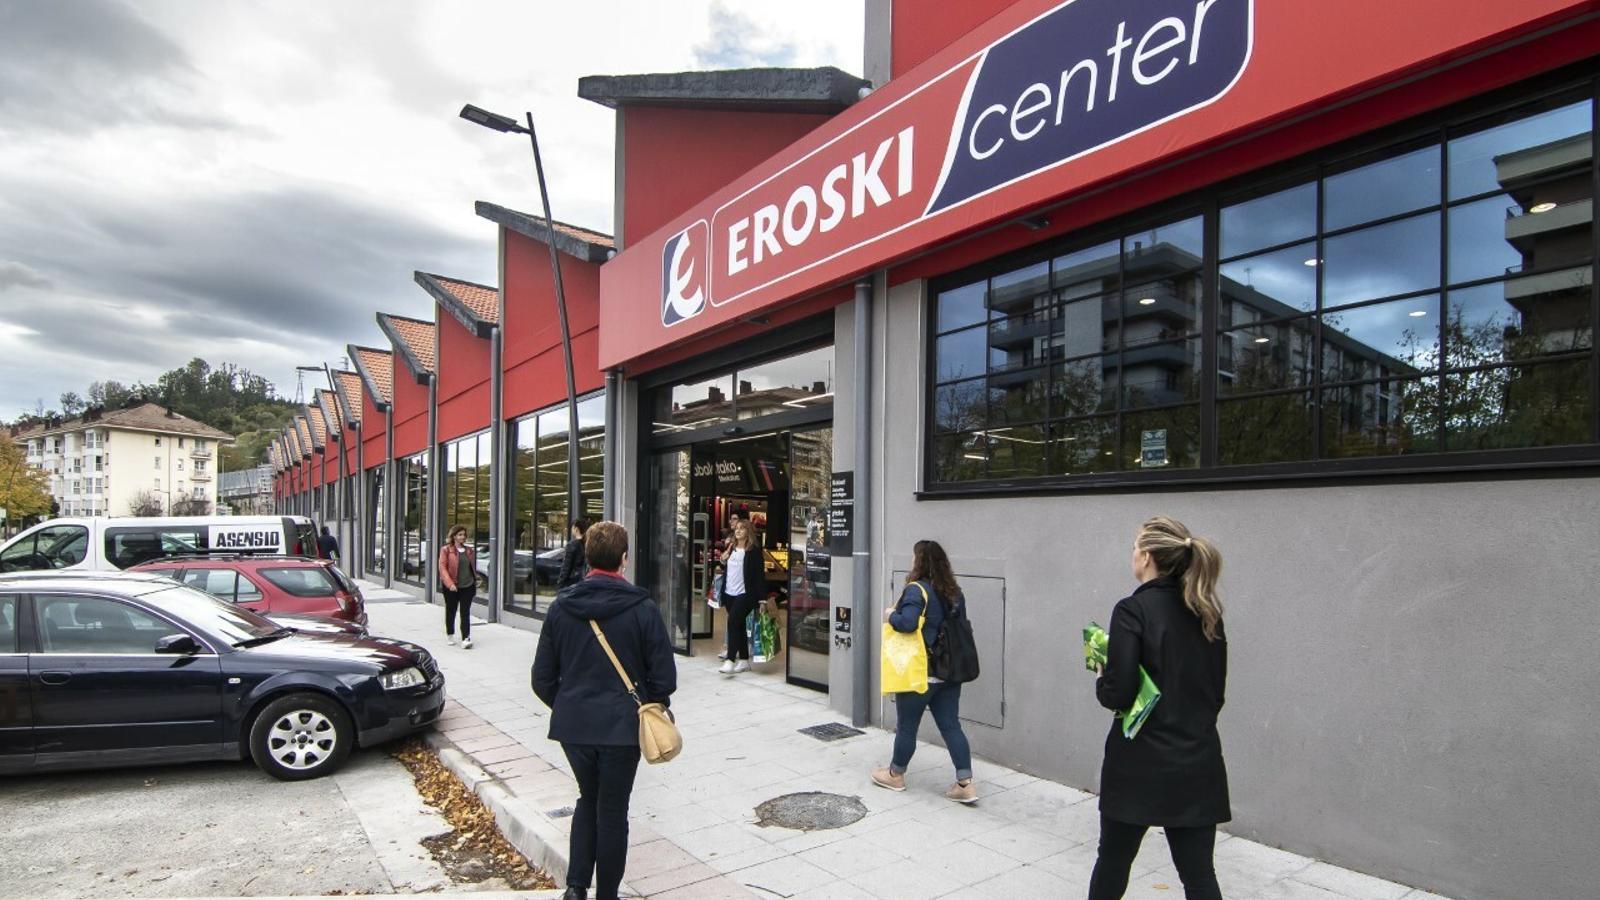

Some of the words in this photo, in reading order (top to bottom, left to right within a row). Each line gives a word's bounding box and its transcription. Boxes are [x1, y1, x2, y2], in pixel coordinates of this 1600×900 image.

[727, 125, 915, 276] EROSKI
[968, 0, 1218, 161] center
[215, 531, 280, 547] ASENSIO
